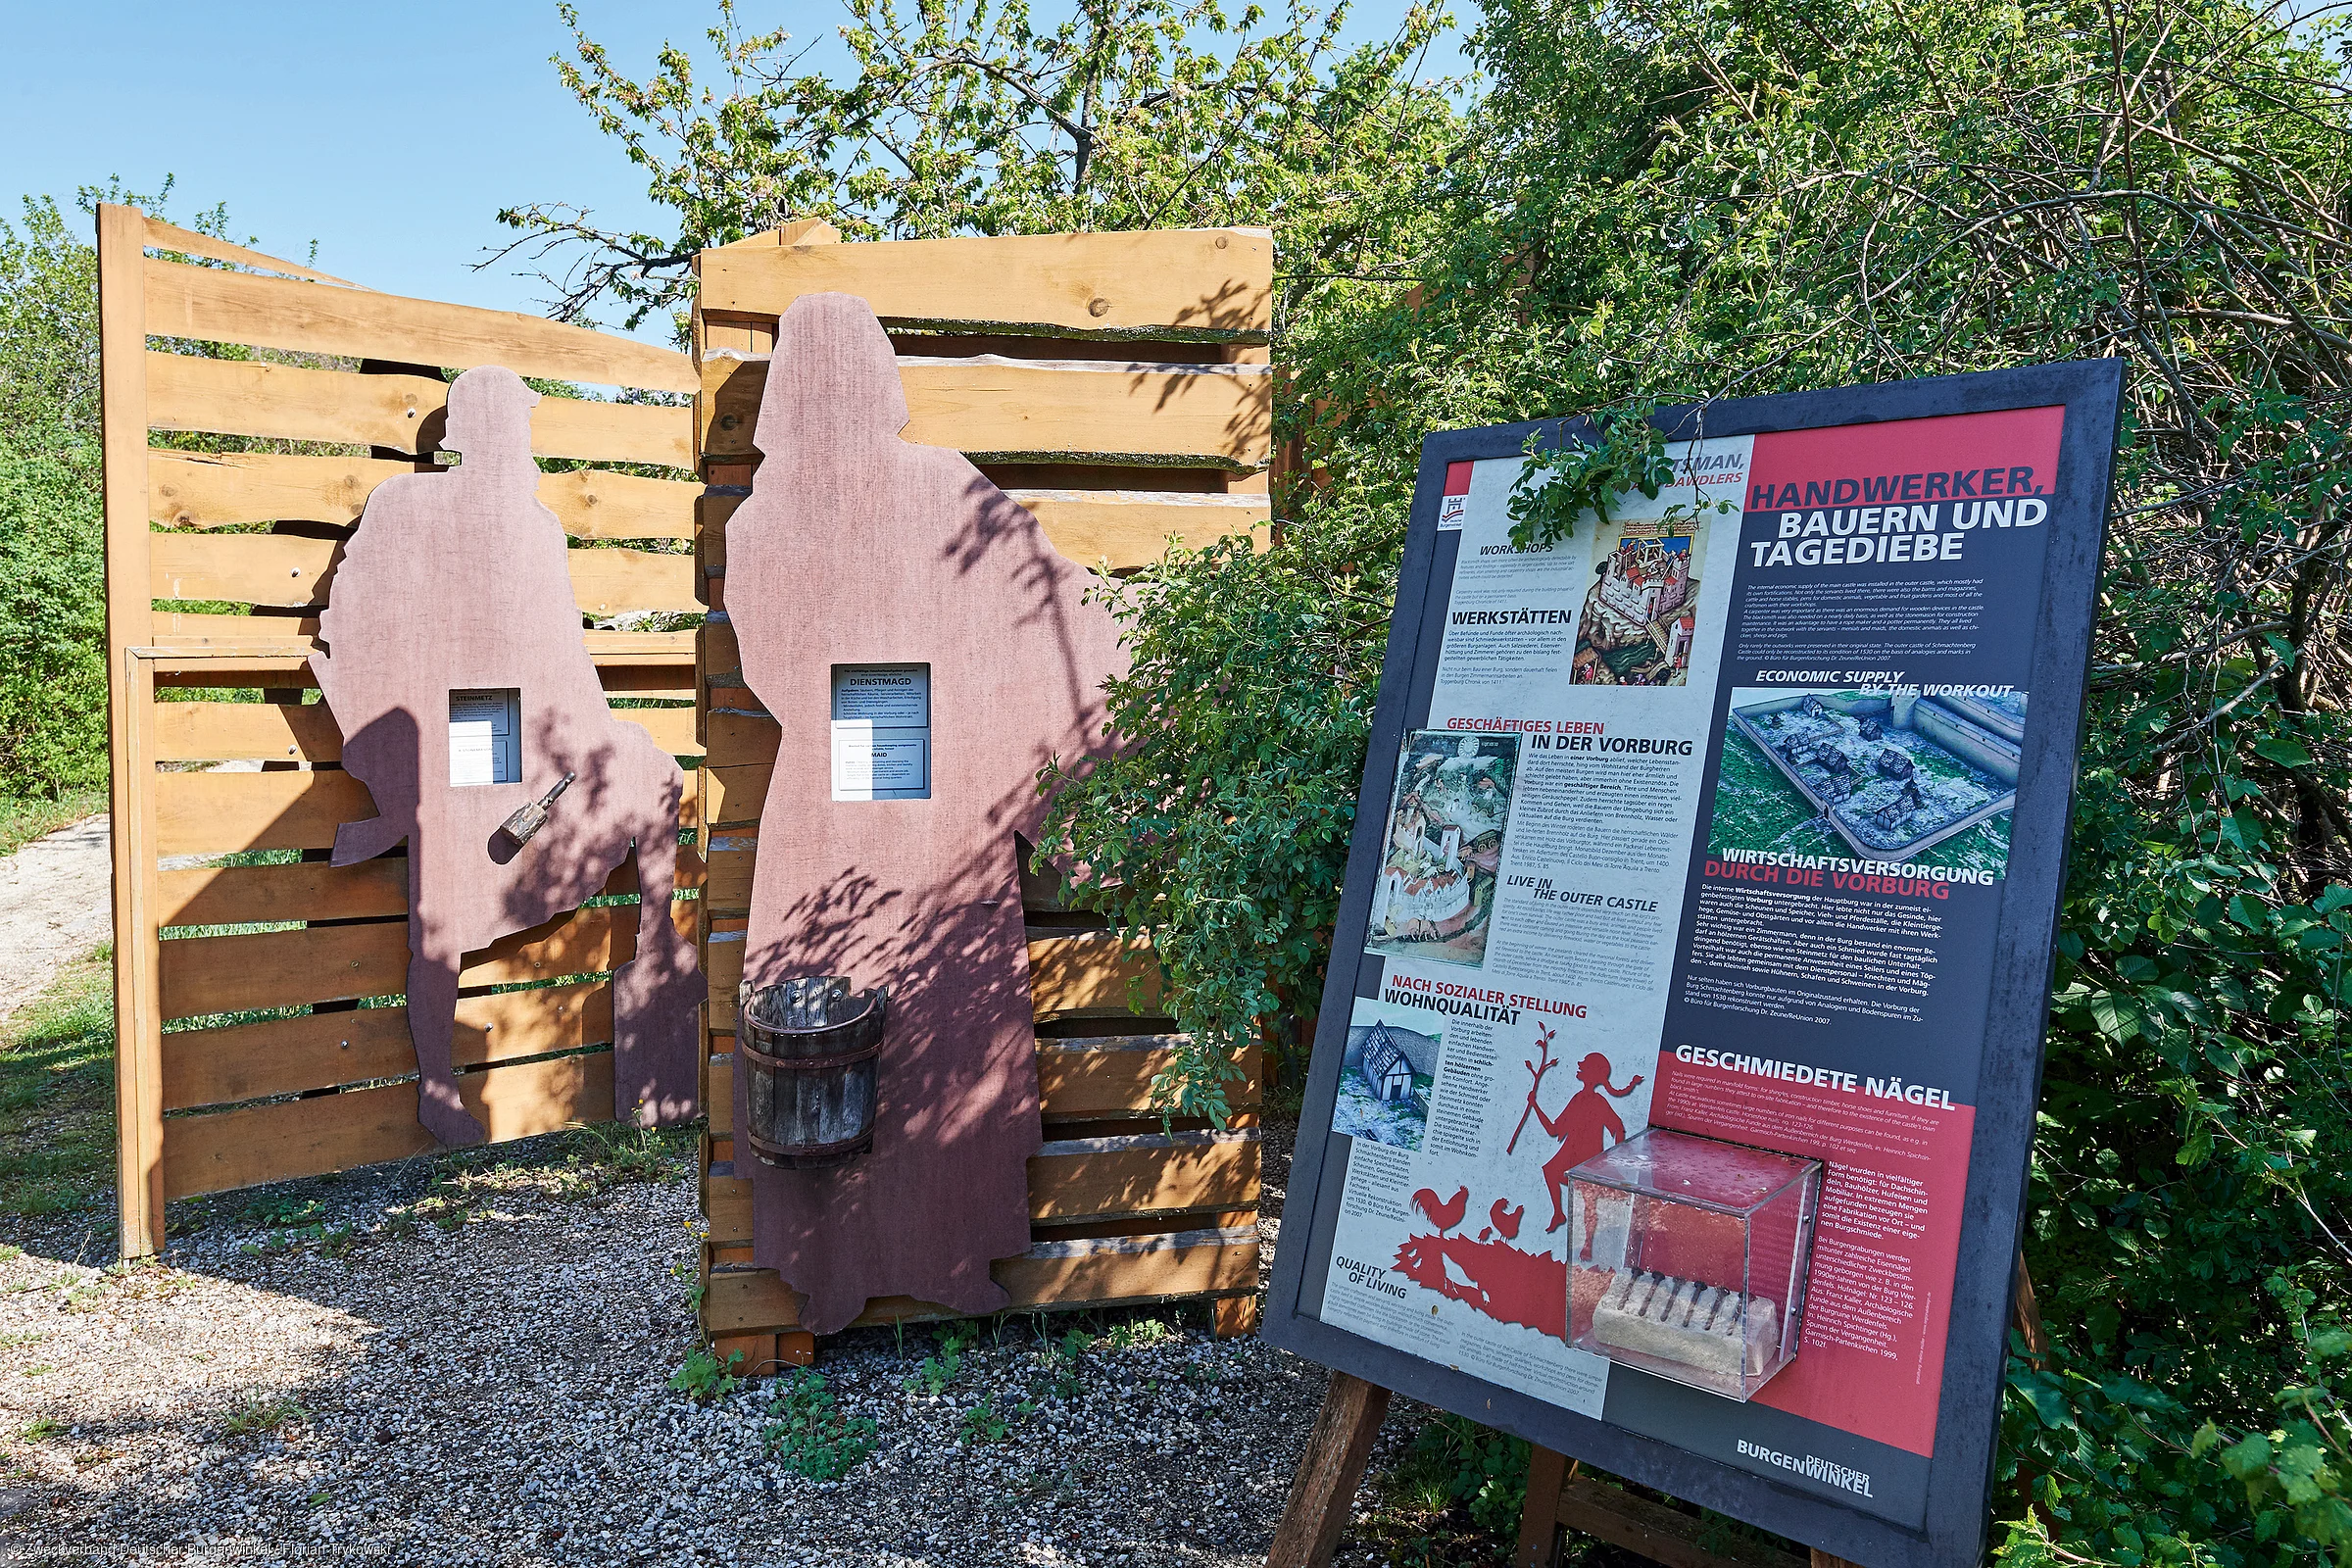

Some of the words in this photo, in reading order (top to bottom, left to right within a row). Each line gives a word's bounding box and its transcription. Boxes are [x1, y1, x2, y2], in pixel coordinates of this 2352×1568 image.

[1672, 454, 1744, 472] TSMAN,
[1751, 466, 2043, 509] HANDWERKER,
[1778, 505, 1938, 538] BAUERN
[1952, 498, 2048, 529] UND
[1480, 543, 1554, 555] WORKHOPS
[1751, 533, 1963, 567] TAGEDIEBE
[1452, 608, 1572, 625] WERKSTÄTTEN
[1755, 670, 1841, 684] ECONOMIC
[1842, 669, 1905, 684] SUPPLY
[1860, 683, 1885, 697] BY
[1886, 684, 1919, 697] THE
[1922, 685, 2014, 698] WORKOUT
[1446, 716, 1551, 733] GESCHÄFTIGES
[1556, 720, 1604, 736] LEBEN
[1531, 734, 1550, 750] IN
[1556, 735, 1593, 751] DER
[1598, 737, 1693, 757] VORBURG
[1722, 848, 1994, 886] WIRTSCHAFTSVERSORGUNG
[1506, 874, 1536, 888] LIVE
[1538, 878, 1553, 890] IN
[1704, 860, 1780, 883] DURCH
[1786, 867, 1825, 887] DIE
[1833, 871, 1949, 900] VORBURG
[1533, 888, 1557, 901] THE
[1559, 891, 1603, 906] OUTER
[1606, 897, 1659, 912] CASTLE
[1700, 892, 1745, 902] genbefestigten
[1746, 896, 1773, 906] Vorburg
[1736, 887, 1811, 902] Wirtschaftsversorgung
[1824, 897, 1859, 906] Hauptburg
[1744, 903, 1774, 912] Scheunen
[1385, 989, 1521, 1025] WOHNQUALITÄT
[1392, 974, 1431, 993] NACH
[1435, 982, 1505, 1004] SOZIALER
[1508, 994, 1588, 1019] STELLUNG
[1675, 1044, 1857, 1094] GESCHMIEDETE
[1865, 1076, 1956, 1111] NÄGEL
[1828, 1169, 1845, 1178] Form
[1829, 1161, 1848, 1171] Nägel
[1849, 1166, 1876, 1177] wurden
[1886, 1173, 1924, 1187] vielfältiger
[1824, 1196, 1868, 1209] aufgefunden
[1869, 1203, 1903, 1217] bezeugen
[1864, 1196, 1897, 1207] extremen
[1898, 1201, 1928, 1214] Mengen
[1882, 1190, 1912, 1201] Hufeisen
[1822, 1211, 1840, 1220] somit
[1853, 1218, 1882, 1230] Existenz
[1883, 1225, 1901, 1235] einer
[1823, 1202, 1838, 1211] eine
[1838, 1205, 1878, 1220] Fabrikation
[1891, 1218, 1903, 1227] Ort
[1336, 1255, 1387, 1280] QUALITY
[1348, 1271, 1364, 1284] OF
[1366, 1277, 1407, 1299] LIVING
[1737, 1439, 1874, 1498] BURGENWINKEL
[1806, 1454, 1870, 1483] DEUTSCHER
